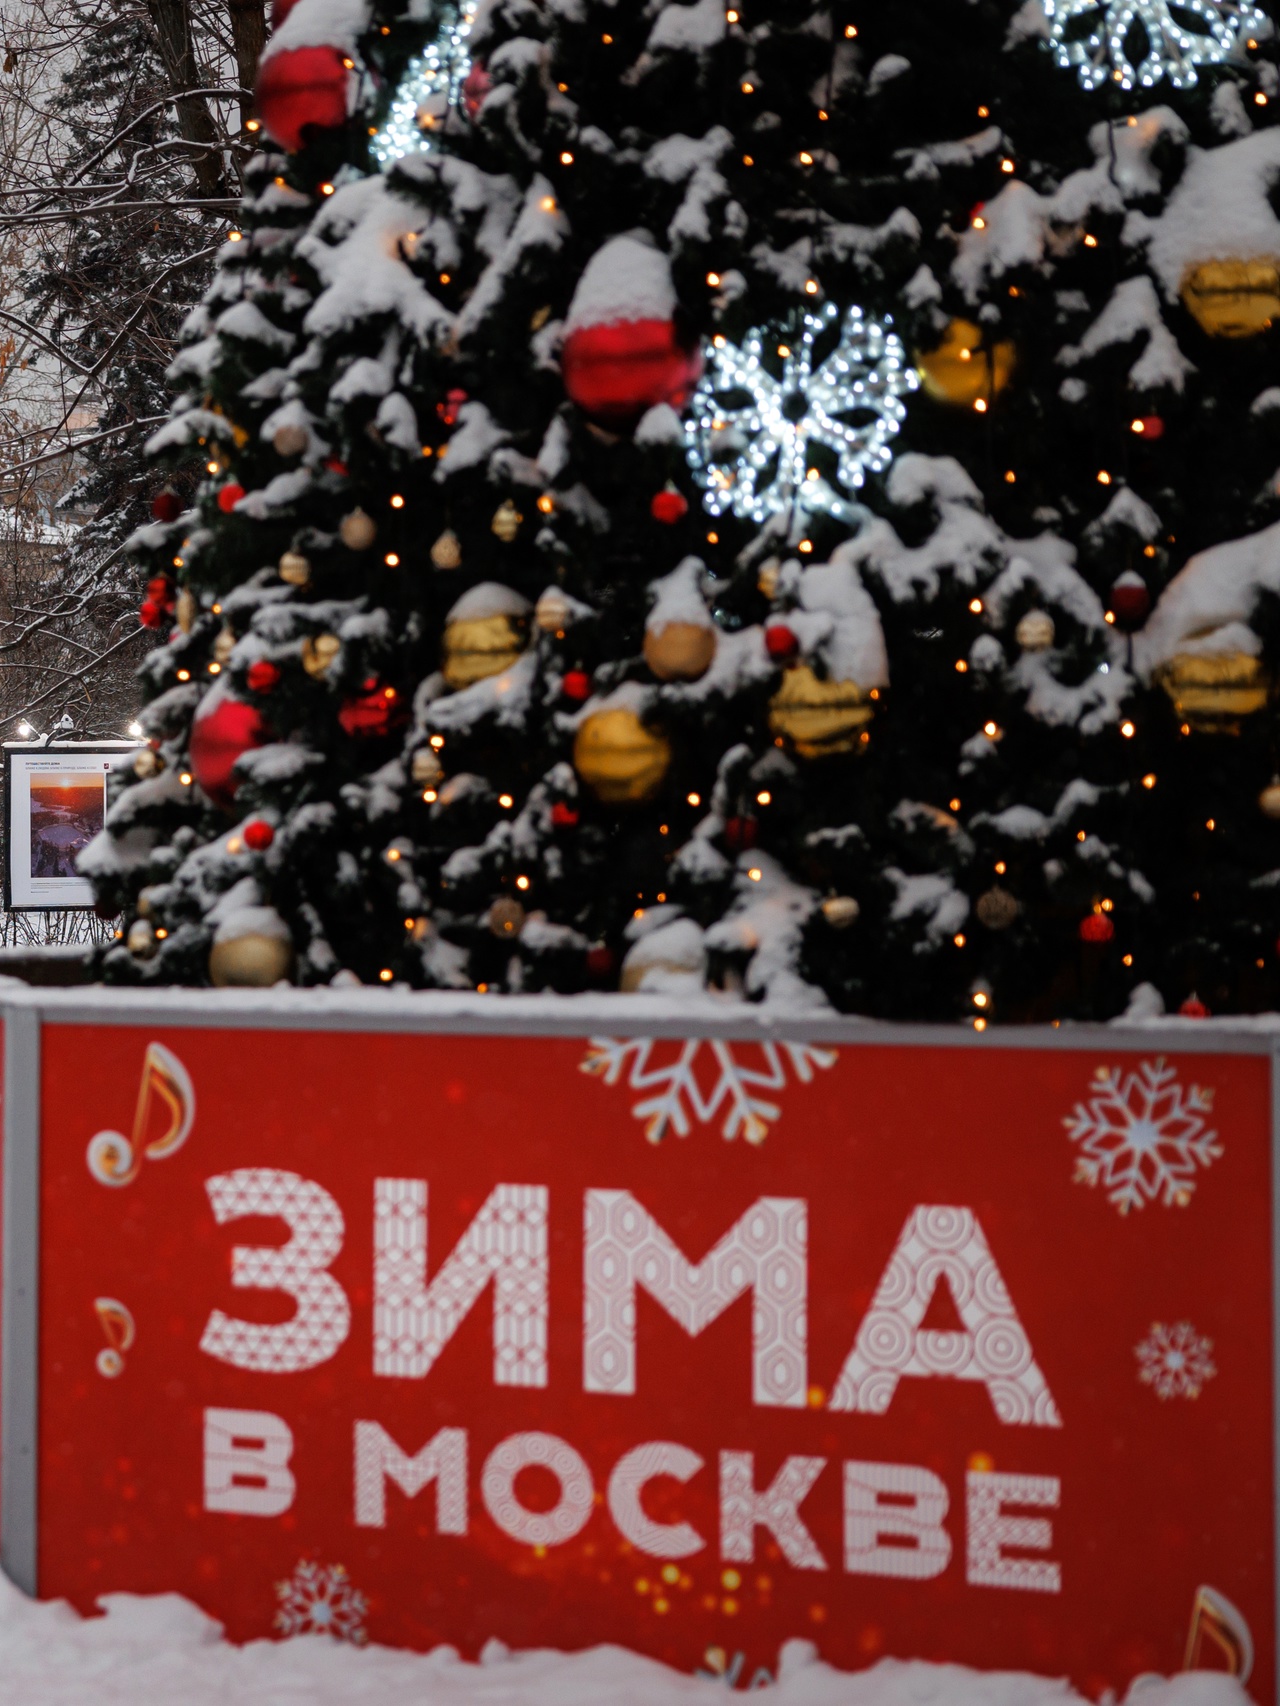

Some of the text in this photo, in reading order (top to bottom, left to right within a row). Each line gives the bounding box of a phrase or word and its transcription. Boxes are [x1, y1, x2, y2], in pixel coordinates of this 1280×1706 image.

[200, 1167, 1063, 1427] ЗИМА
[204, 1408, 1061, 1591] В МОСКВЕ
